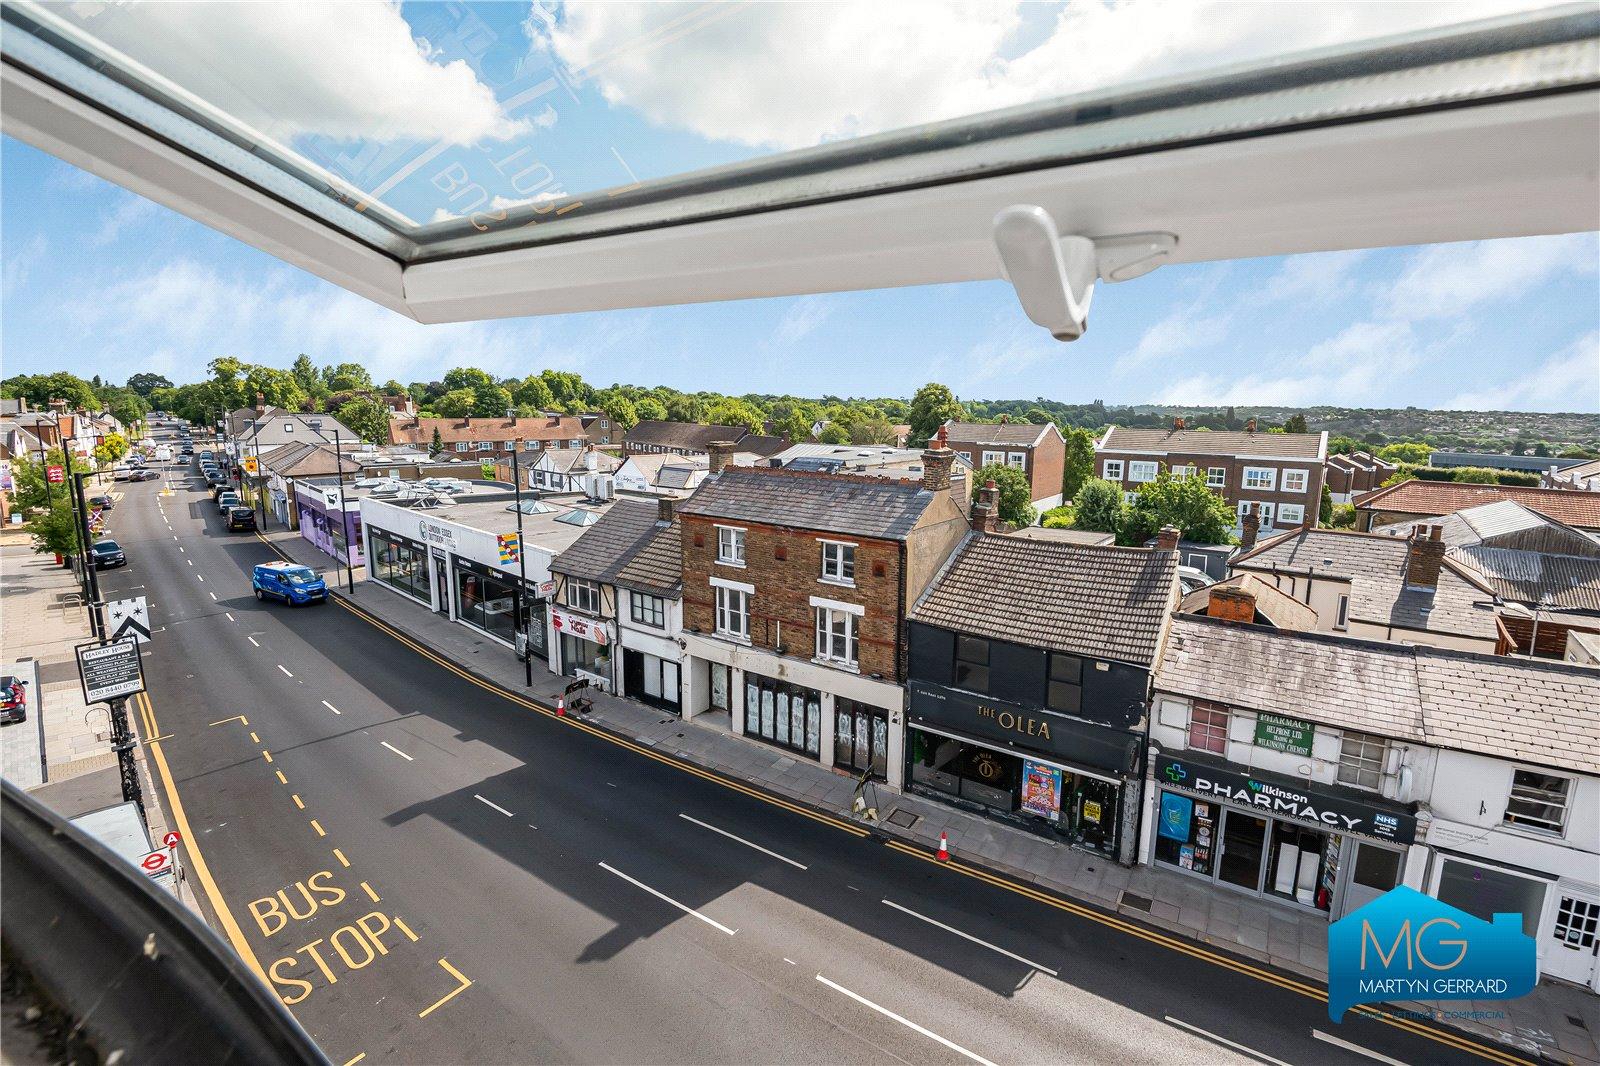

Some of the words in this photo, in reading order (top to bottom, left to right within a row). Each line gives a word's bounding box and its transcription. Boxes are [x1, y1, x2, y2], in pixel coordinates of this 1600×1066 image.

[441, 528, 452, 538] ESSEX
[85, 649, 110, 659] HADLEY
[112, 644, 130, 653] HOUSE
[88, 656, 117, 665] RESTAURANT
[96, 667, 118, 675] WEATHER
[91, 689, 104, 697] 020
[105, 684, 122, 692] 8440
[123, 680, 140, 689] 0799
[978, 705, 995, 718] THE
[998, 712, 1050, 740] OLEA
[1260, 714, 1311, 730] PHARMACY
[1266, 725, 1291, 737] HELPROSE
[1292, 730, 1302, 739] LTD
[1286, 744, 1308, 755] CHEMIST
[1248, 780, 1308, 804] Wilkinson
[1195, 778, 1362, 829] PHARMACY
[1374, 821, 1397, 831] Providing
[1376, 814, 1397, 826] NHS
[167, 833, 178, 845] A
[1374, 828, 1394, 837] Services
[248, 871, 346, 938] BUS
[268, 911, 391, 1005] STOP
